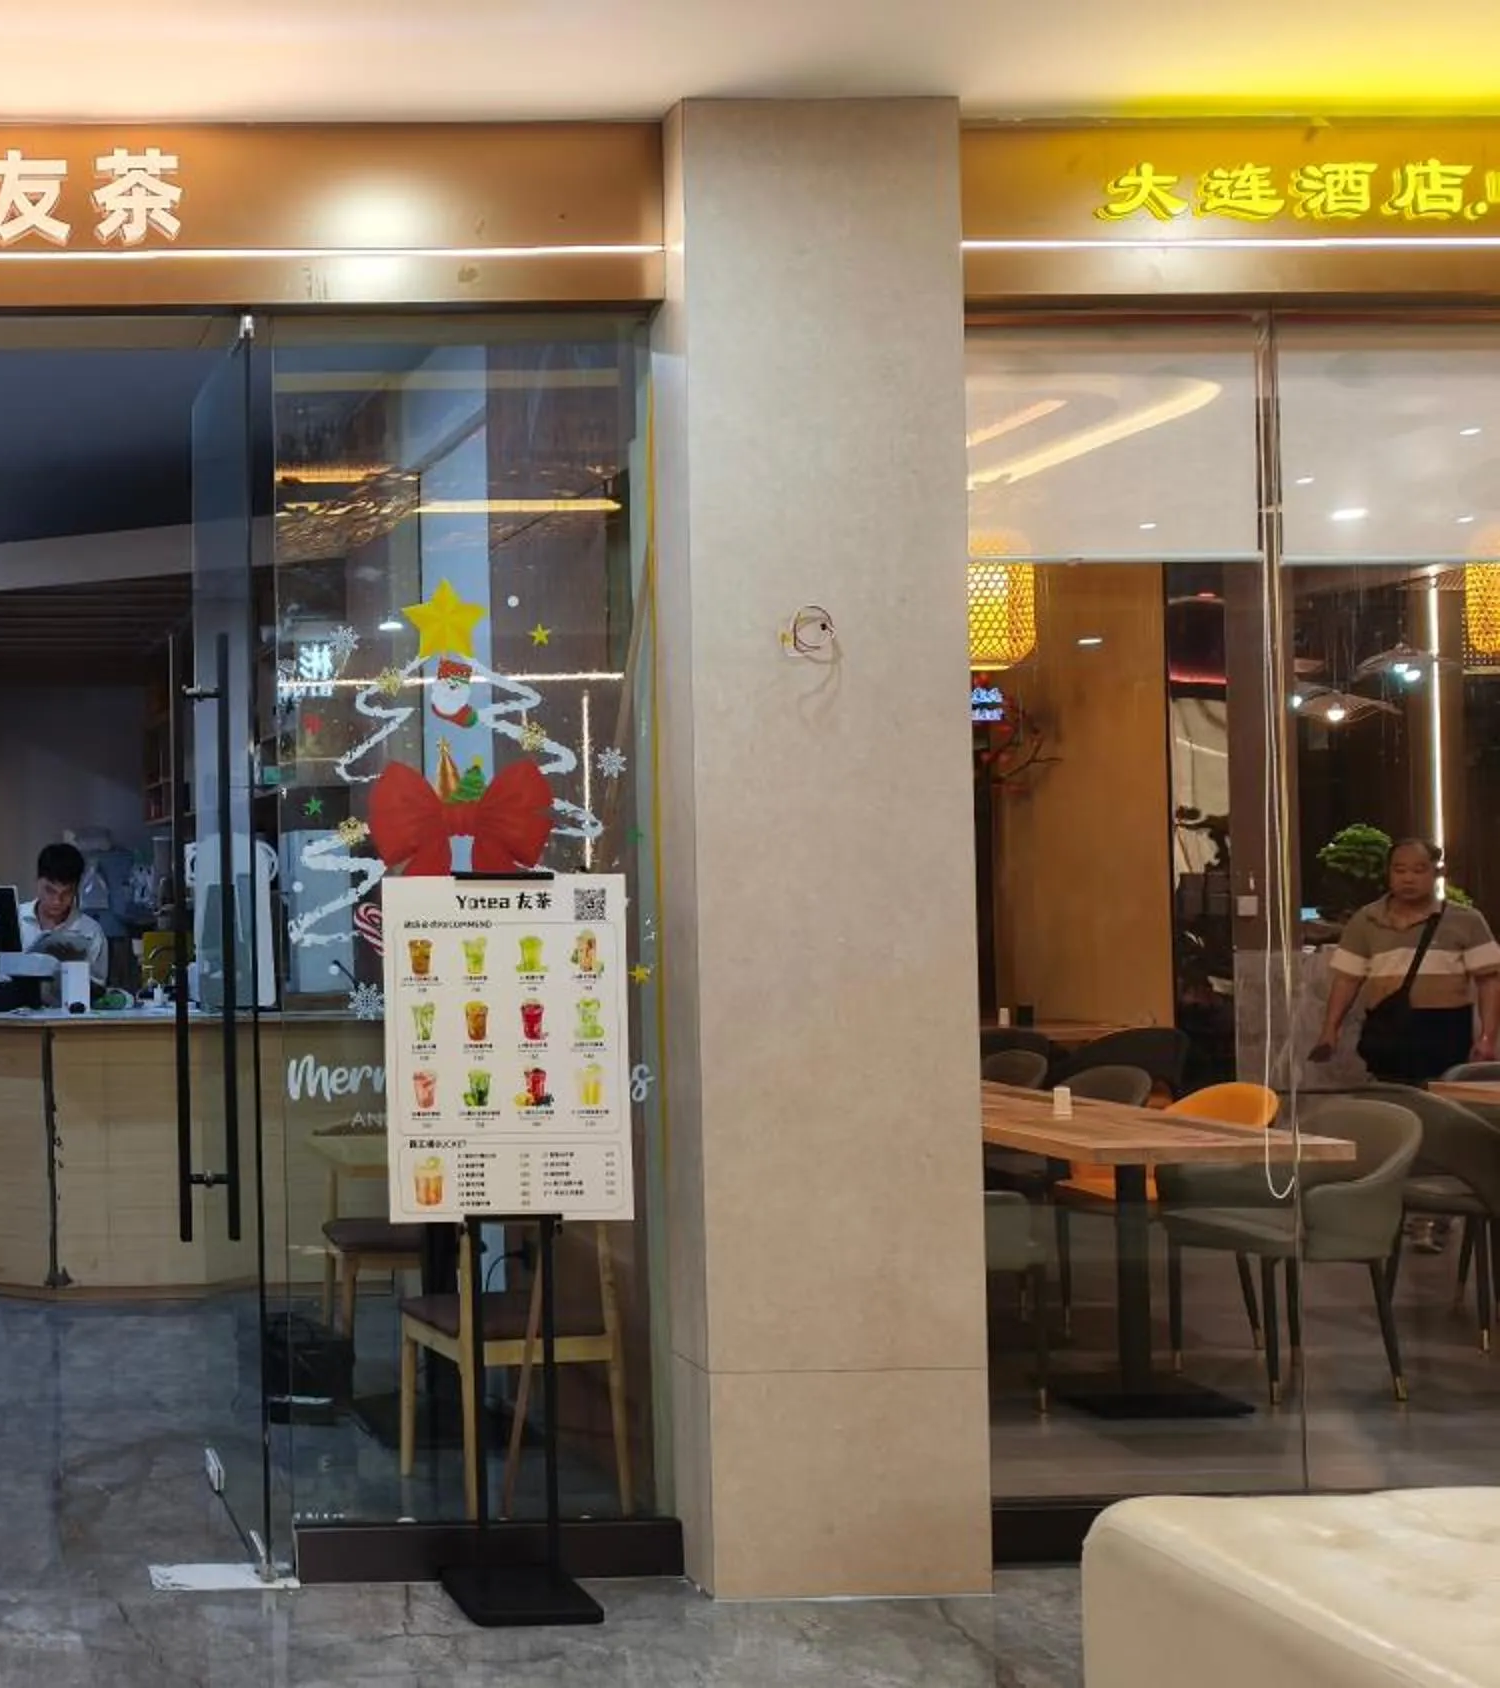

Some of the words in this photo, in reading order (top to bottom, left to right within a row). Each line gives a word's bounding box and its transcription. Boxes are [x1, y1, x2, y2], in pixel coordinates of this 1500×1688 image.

[455, 895, 511, 910] Yotea
[515, 891, 552, 910] 友茶
[286, 1053, 387, 1103] Merr
